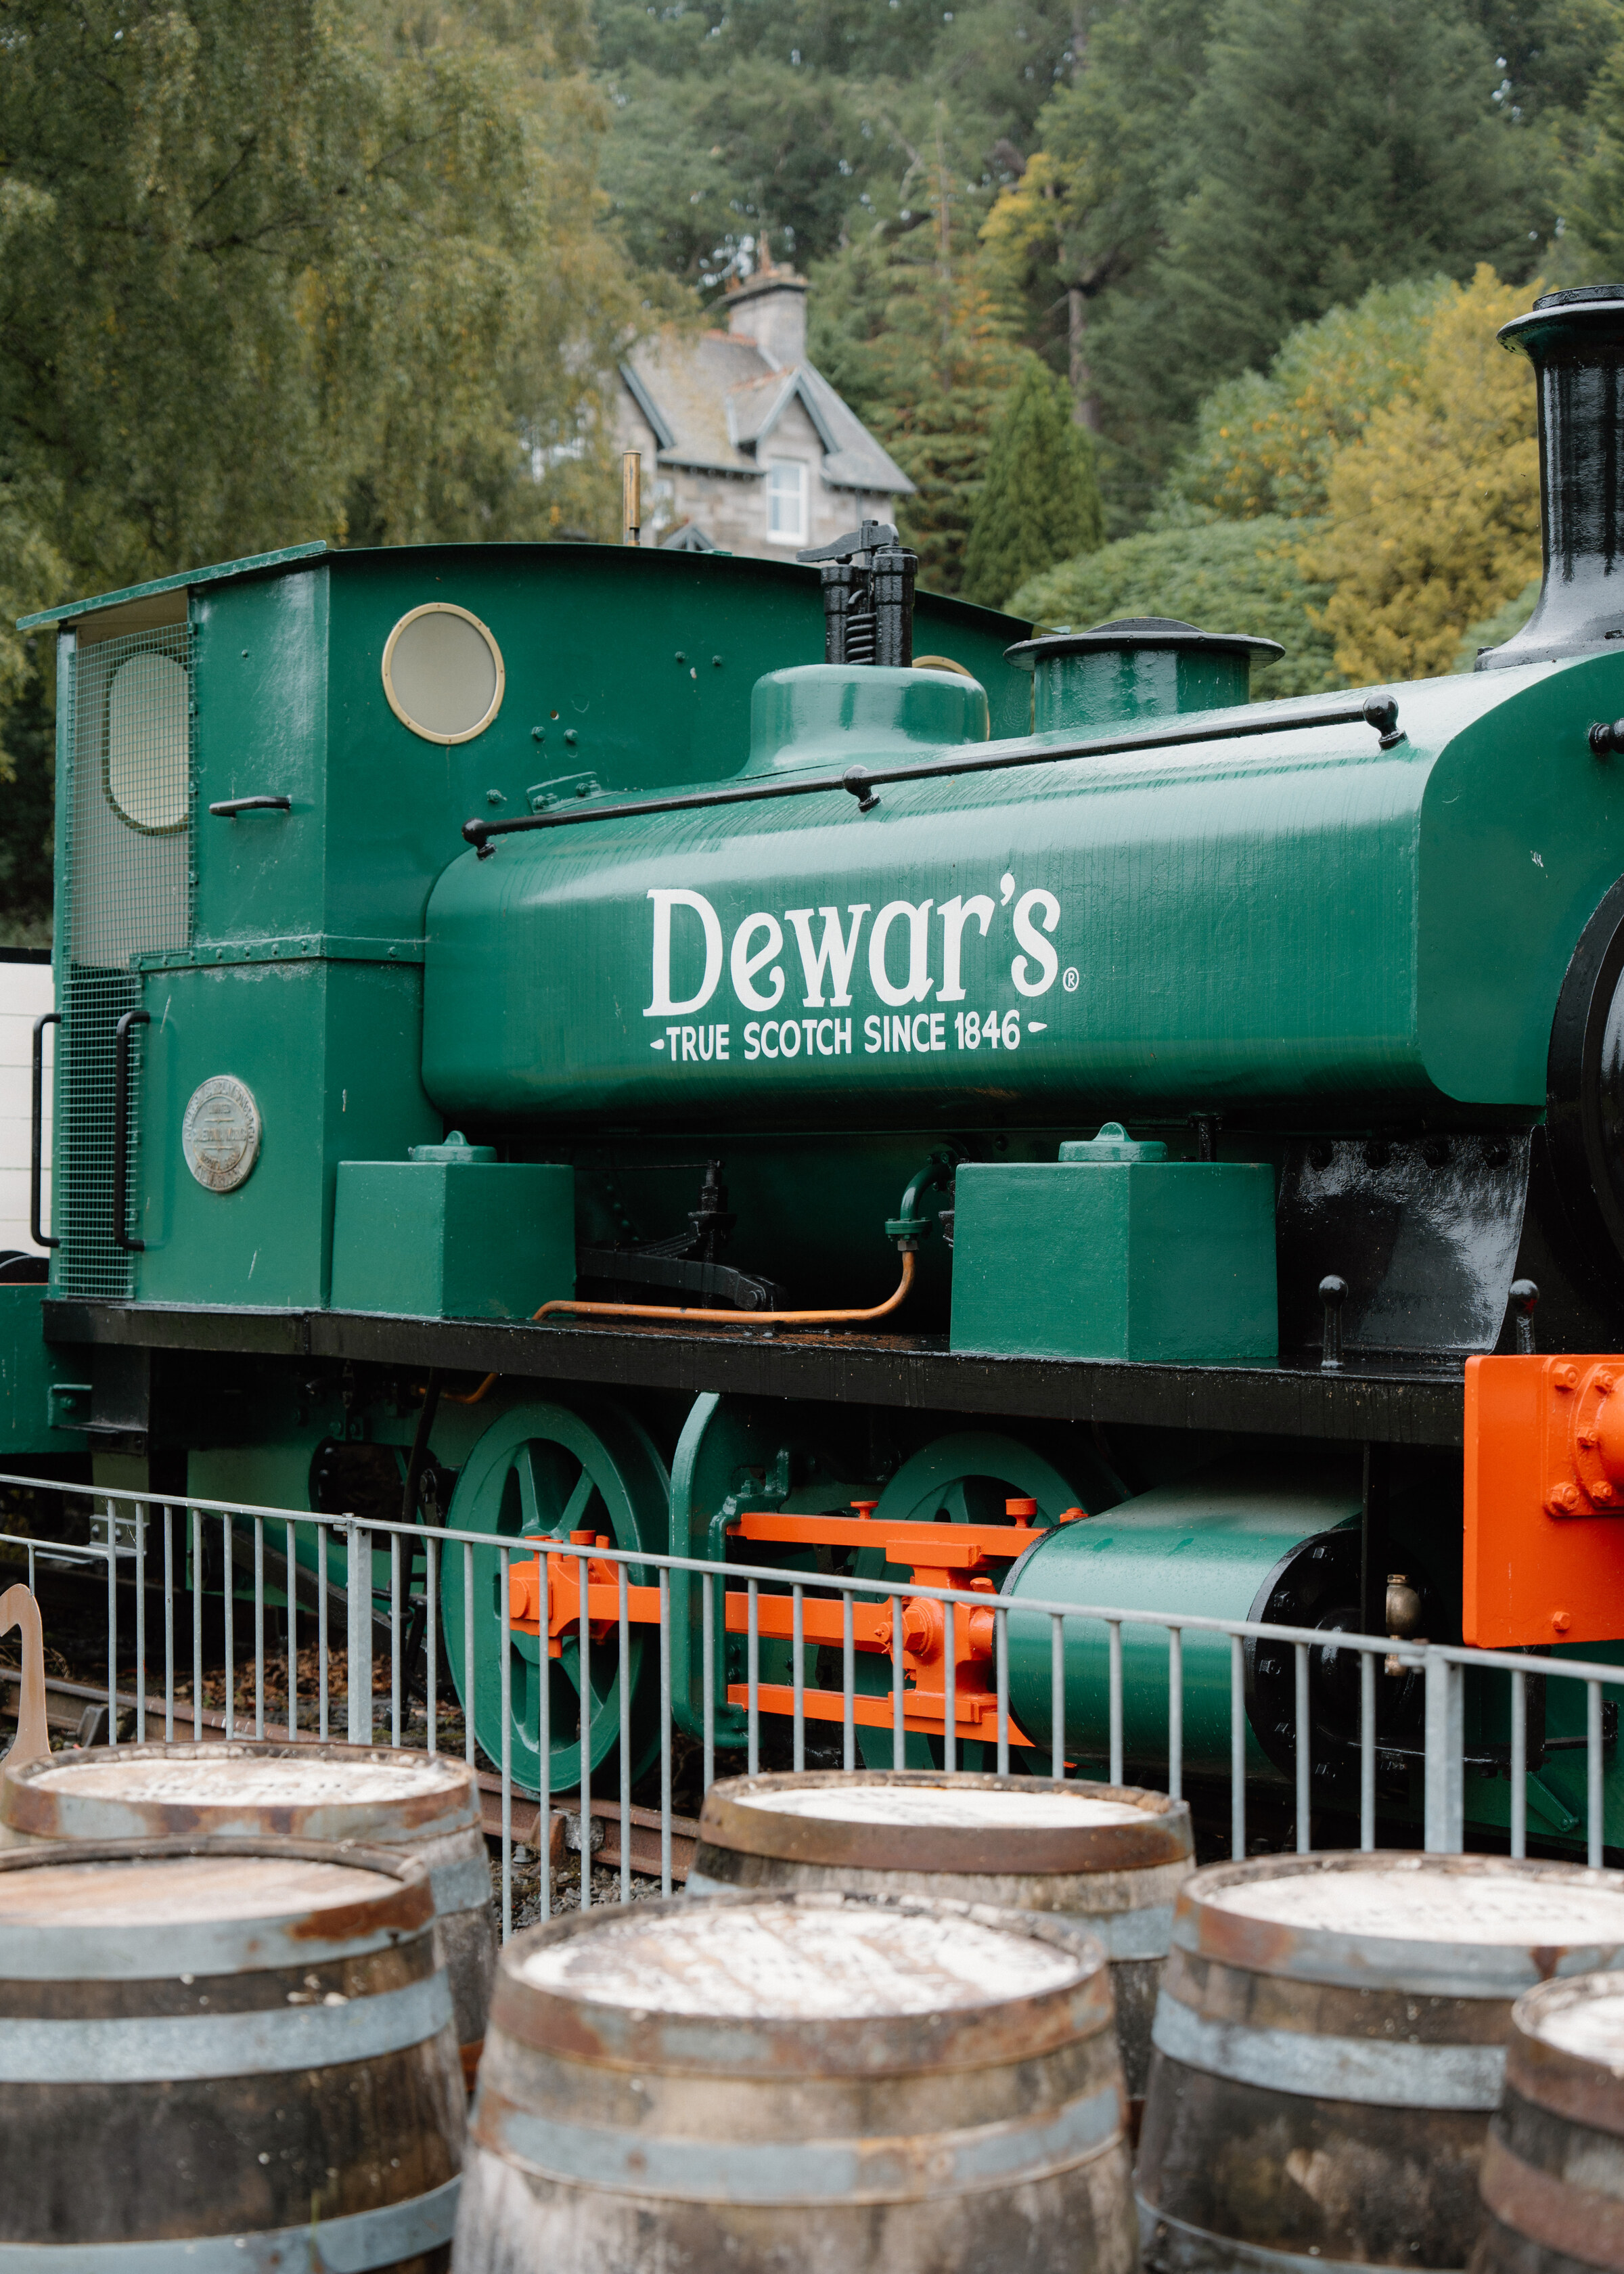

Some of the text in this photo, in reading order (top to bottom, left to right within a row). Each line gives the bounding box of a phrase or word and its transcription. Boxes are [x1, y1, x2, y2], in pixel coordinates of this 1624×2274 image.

[667, 1010, 1020, 1060] TRUE SCOTCH SINCE 1846
